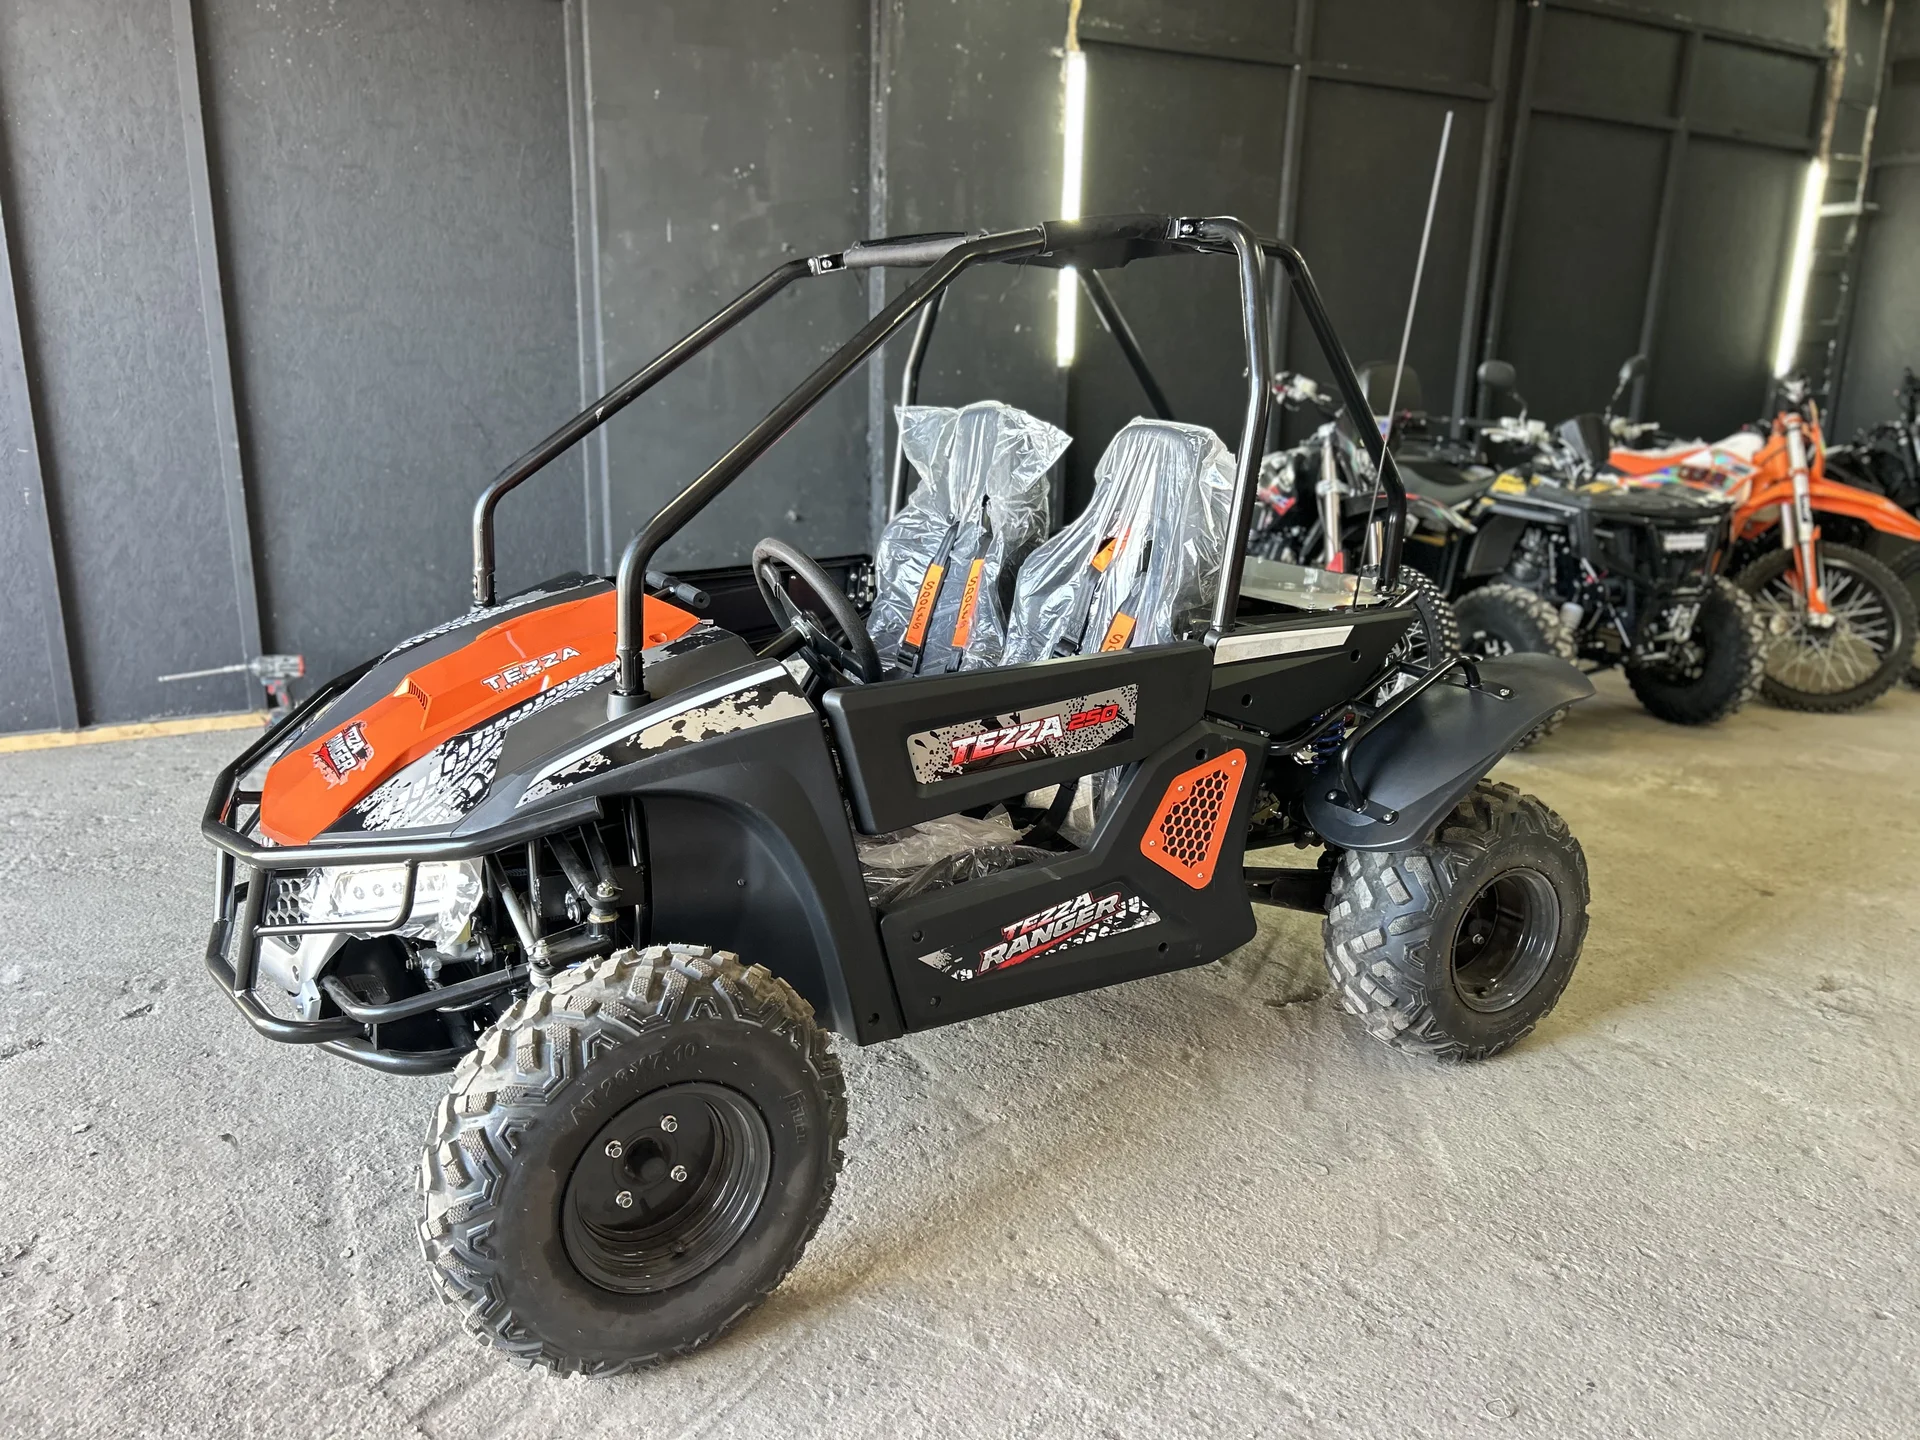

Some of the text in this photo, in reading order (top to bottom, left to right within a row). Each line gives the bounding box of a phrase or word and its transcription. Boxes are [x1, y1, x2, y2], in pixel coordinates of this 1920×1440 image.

[910, 580, 936, 630] Sports
[482, 646, 581, 690] TEZZA
[951, 703, 1120, 766] TEZZA 250
[979, 893, 1121, 973] RANGER
[1002, 891, 1094, 940] TEZZA
